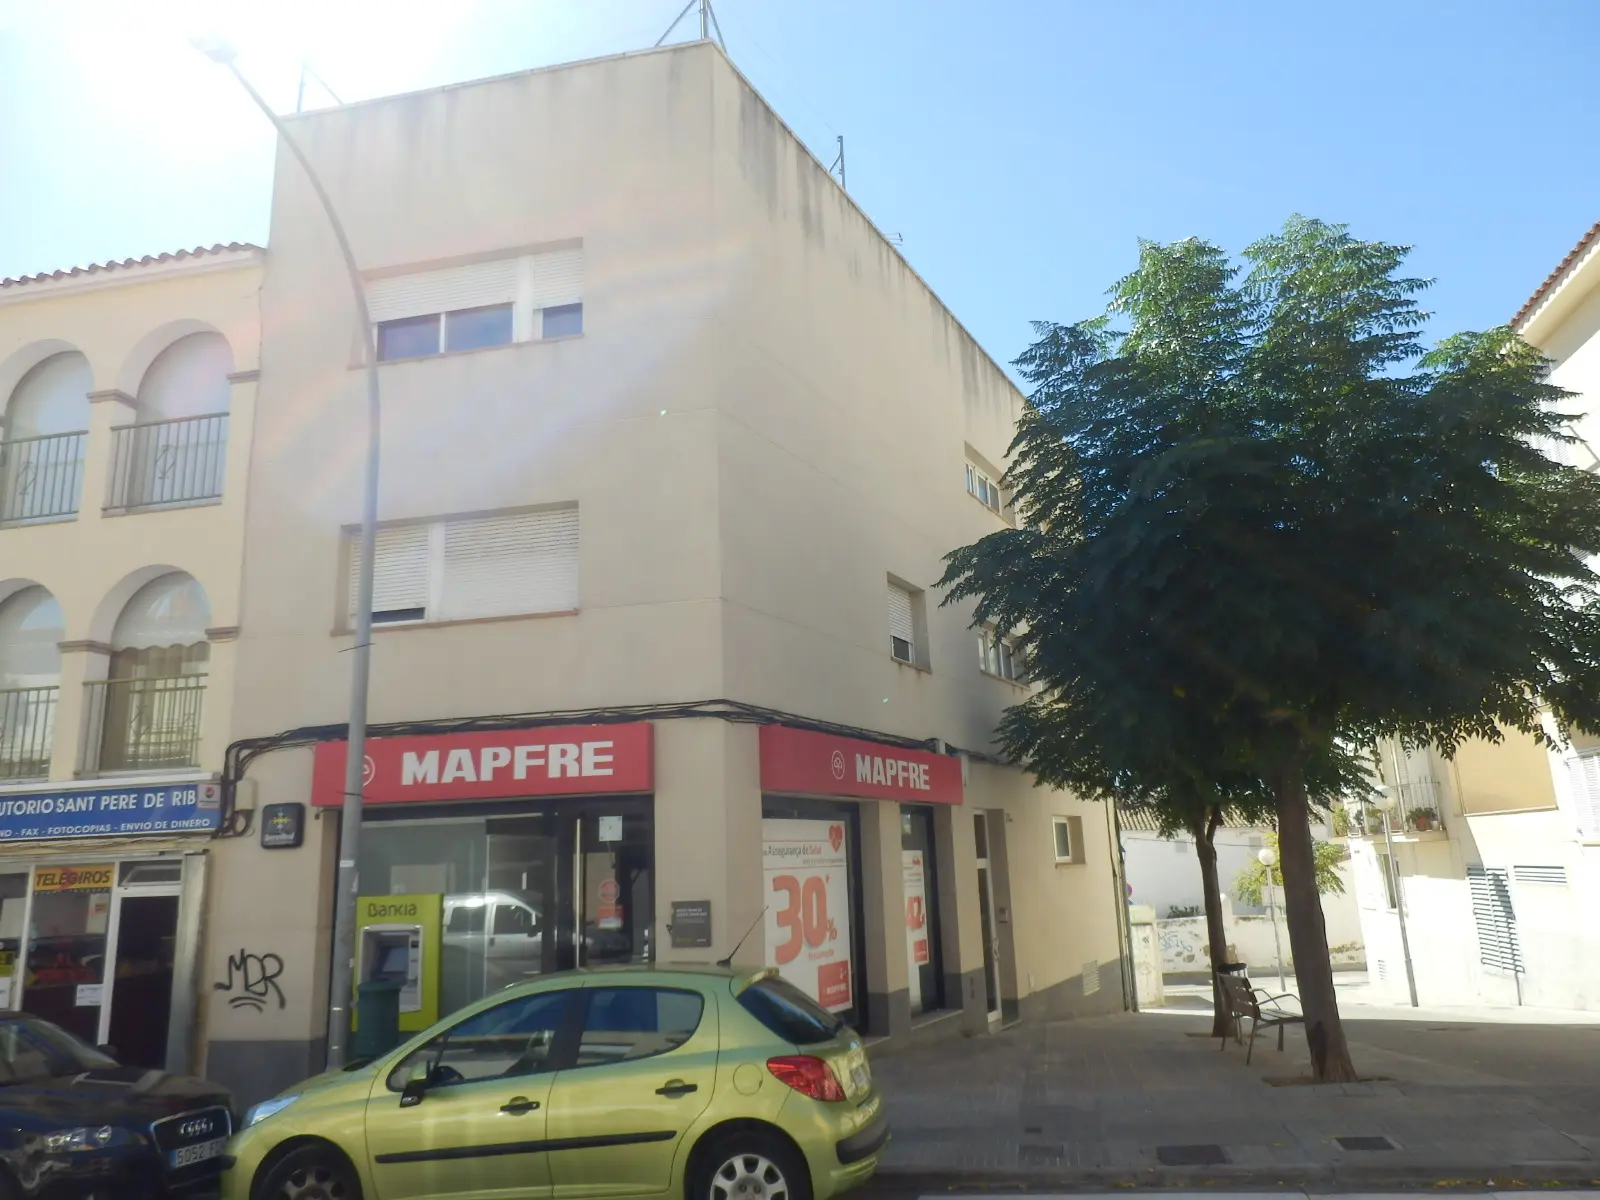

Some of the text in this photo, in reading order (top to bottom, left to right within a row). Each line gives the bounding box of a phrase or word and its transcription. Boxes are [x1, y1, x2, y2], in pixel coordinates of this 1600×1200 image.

[402, 740, 614, 786] MAPFRE
[855, 753, 931, 790] MAPFRE
[56, 796, 96, 813] SANT
[100, 793, 138, 811] PERE
[143, 792, 165, 808] DE
[21, 828, 39, 837] FAX
[47, 824, 111, 835] FOTOCOPIAS
[121, 822, 152, 831] ENVIO
[155, 821, 168, 829] DE
[171, 818, 211, 829] DINERO
[35, 870, 111, 887] TELEGIROS
[368, 903, 417, 918] Bankia
